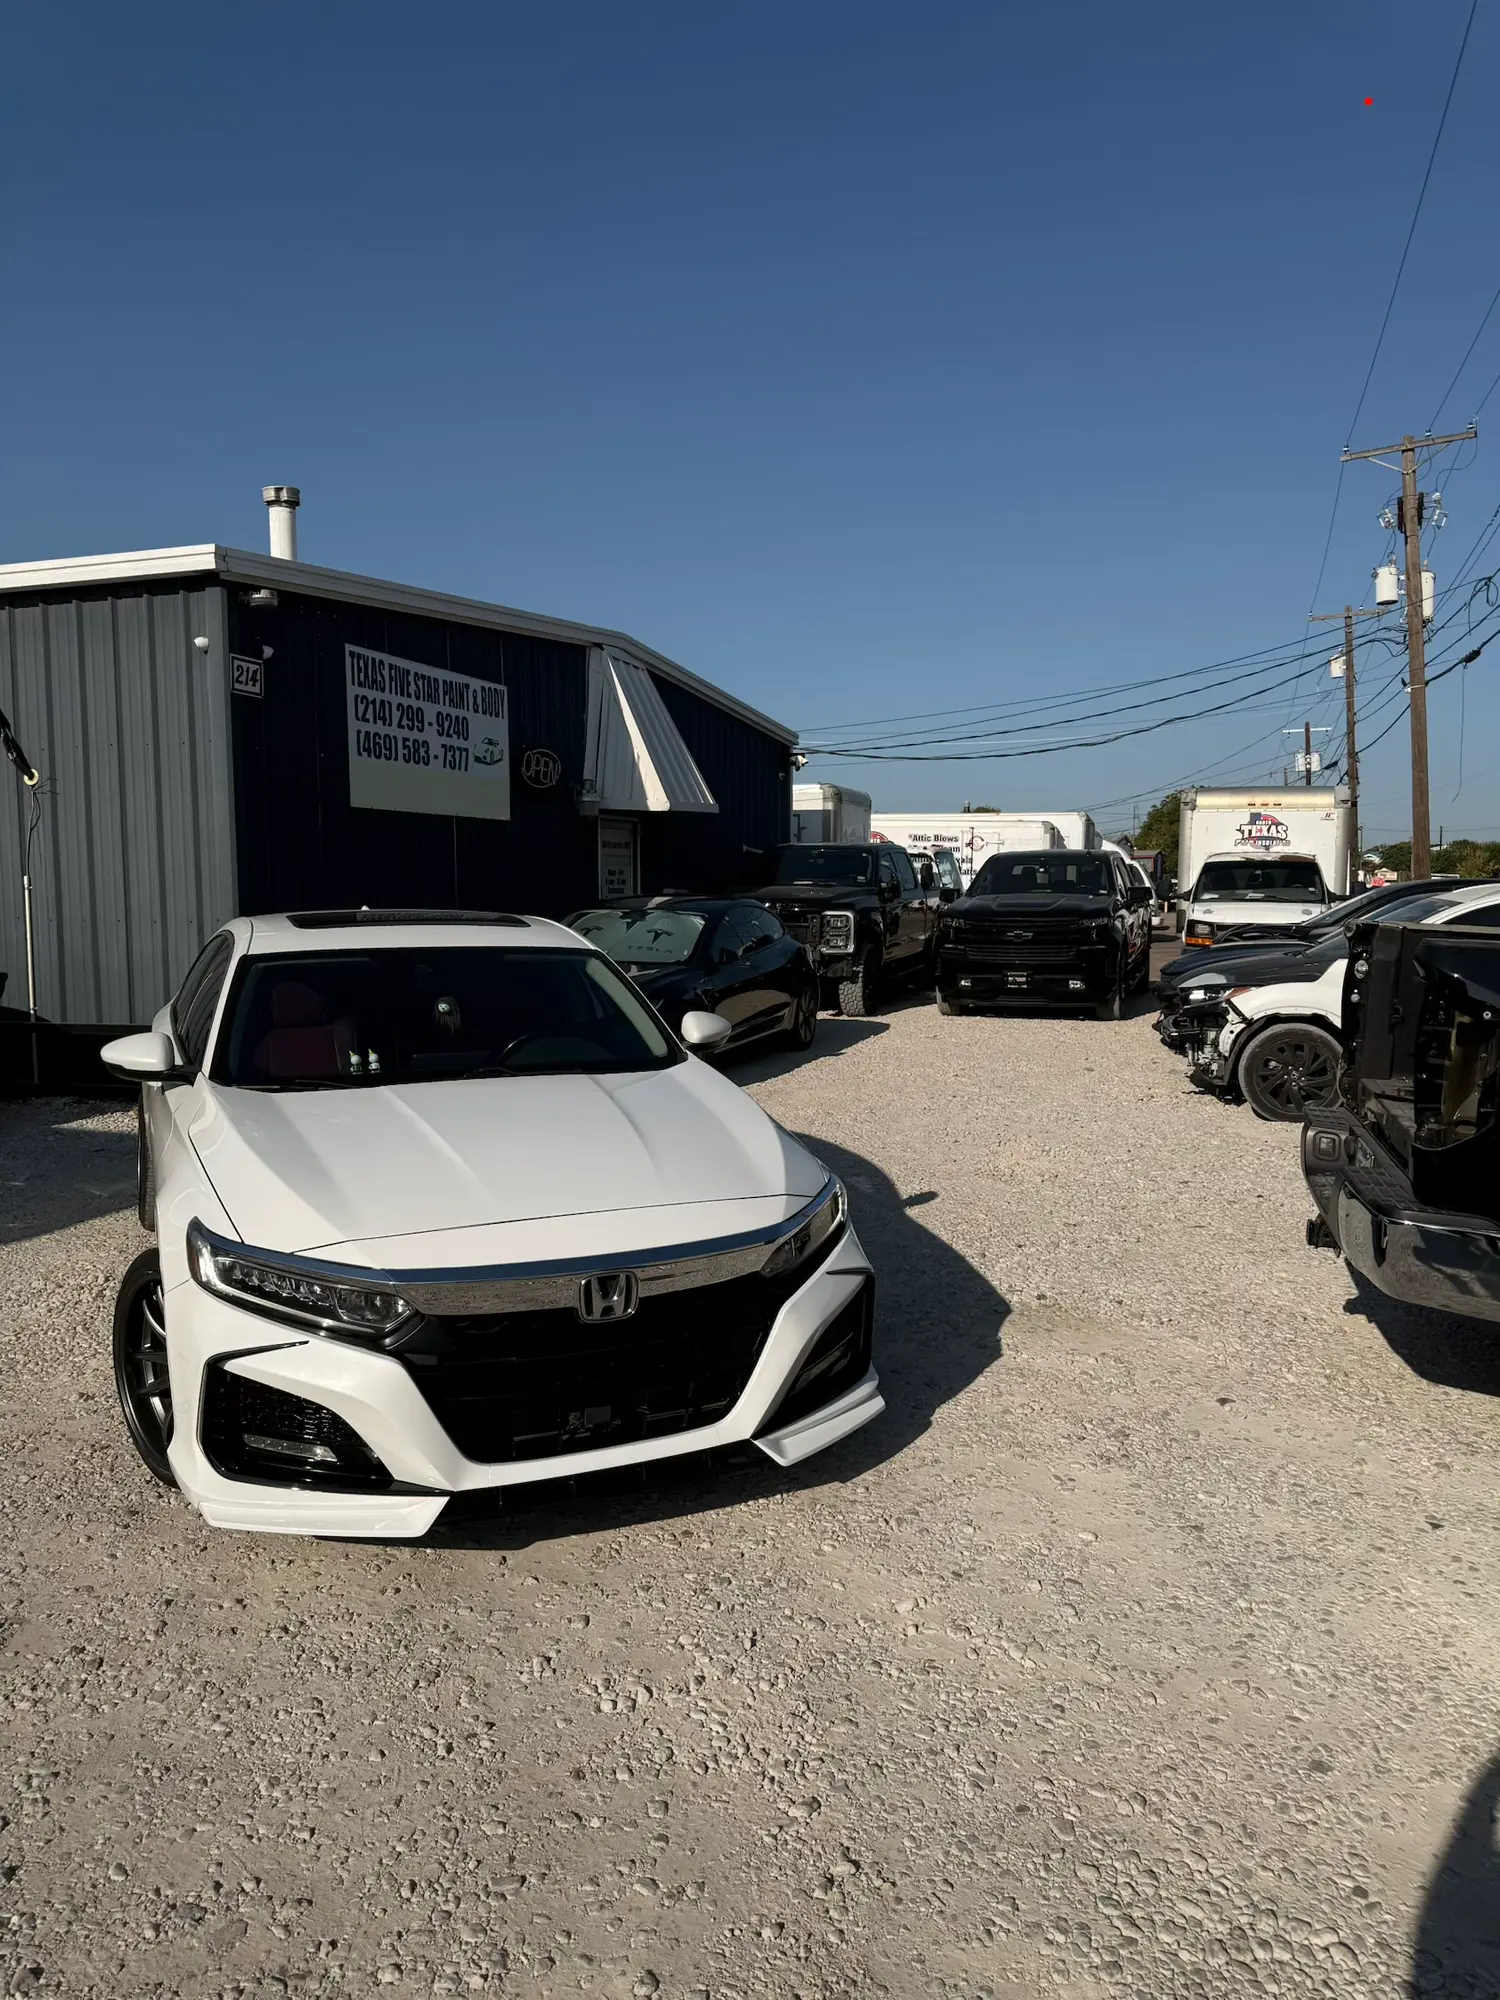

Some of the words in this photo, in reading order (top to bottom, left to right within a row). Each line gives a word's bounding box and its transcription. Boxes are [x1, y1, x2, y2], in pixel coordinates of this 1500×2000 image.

[235, 664, 259, 687] 214
[348, 650, 386, 694] TEXAS
[388, 662, 412, 699] FIVE
[413, 671, 441, 706] STAR
[442, 678, 470, 713] PAINT
[472, 688, 480, 715] &
[480, 685, 505, 720] BODY
[354, 693, 393, 727] (214)
[396, 702, 425, 734] 299
[436, 710, 470, 742] 9240
[356, 729, 399, 762] (469)
[402, 736, 430, 767] 583
[441, 743, 469, 773] 7377
[523, 751, 558, 785] OPEN
[933, 833, 959, 842] Blows
[1240, 824, 1287, 840] TEXAS
